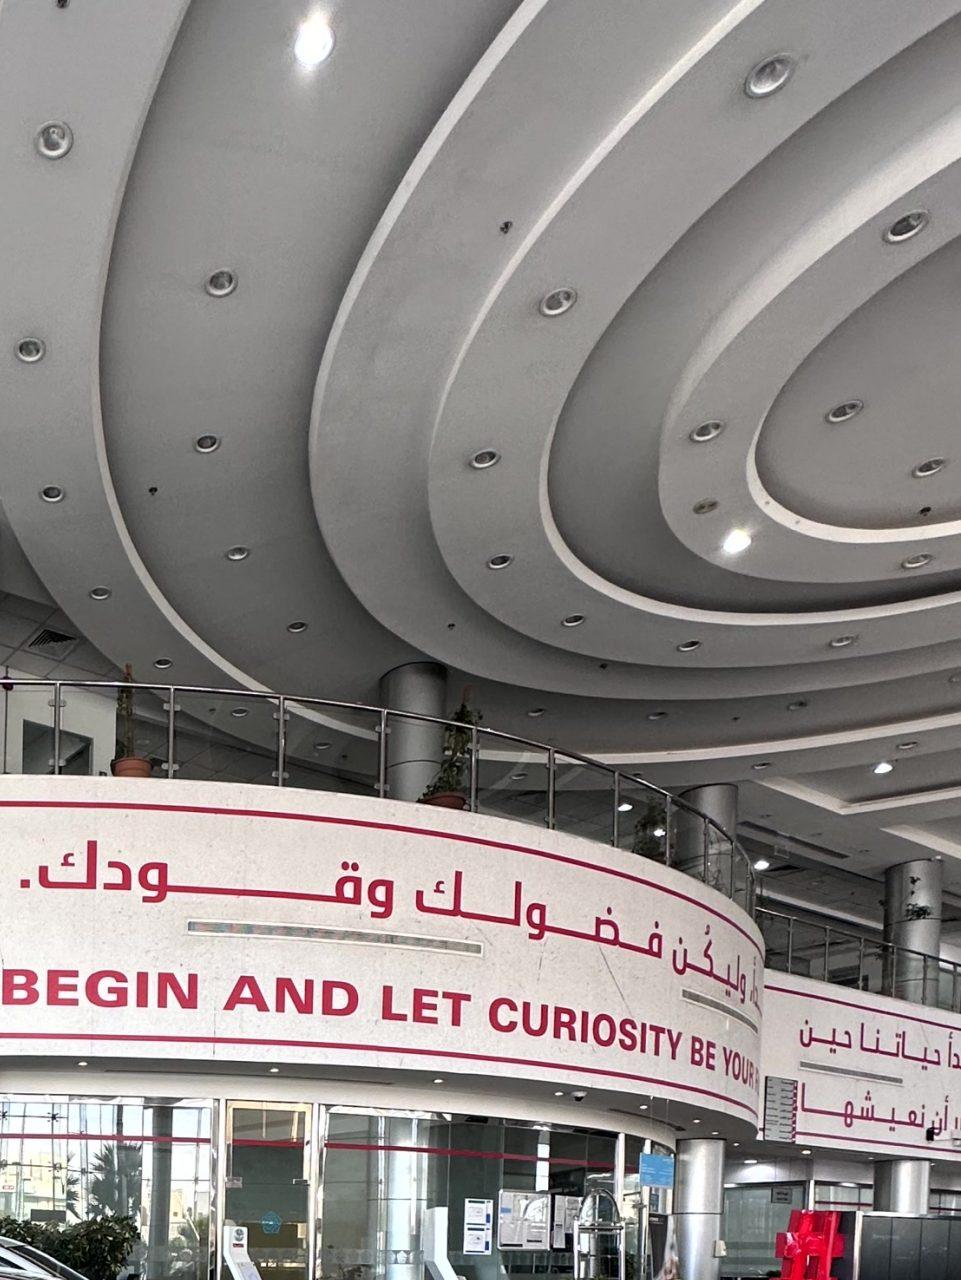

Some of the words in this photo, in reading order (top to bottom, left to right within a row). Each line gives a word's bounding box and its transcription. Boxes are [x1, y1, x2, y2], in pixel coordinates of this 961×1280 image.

[414, 870, 664, 960] فضولك
[2, 968, 199, 1010] BEGIN
[223, 975, 360, 1017] AND
[381, 985, 473, 1028] LET
[489, 996, 683, 1061] CURIOSITY
[690, 1035, 716, 1072] BE
[722, 1045, 755, 1090] YOUR
